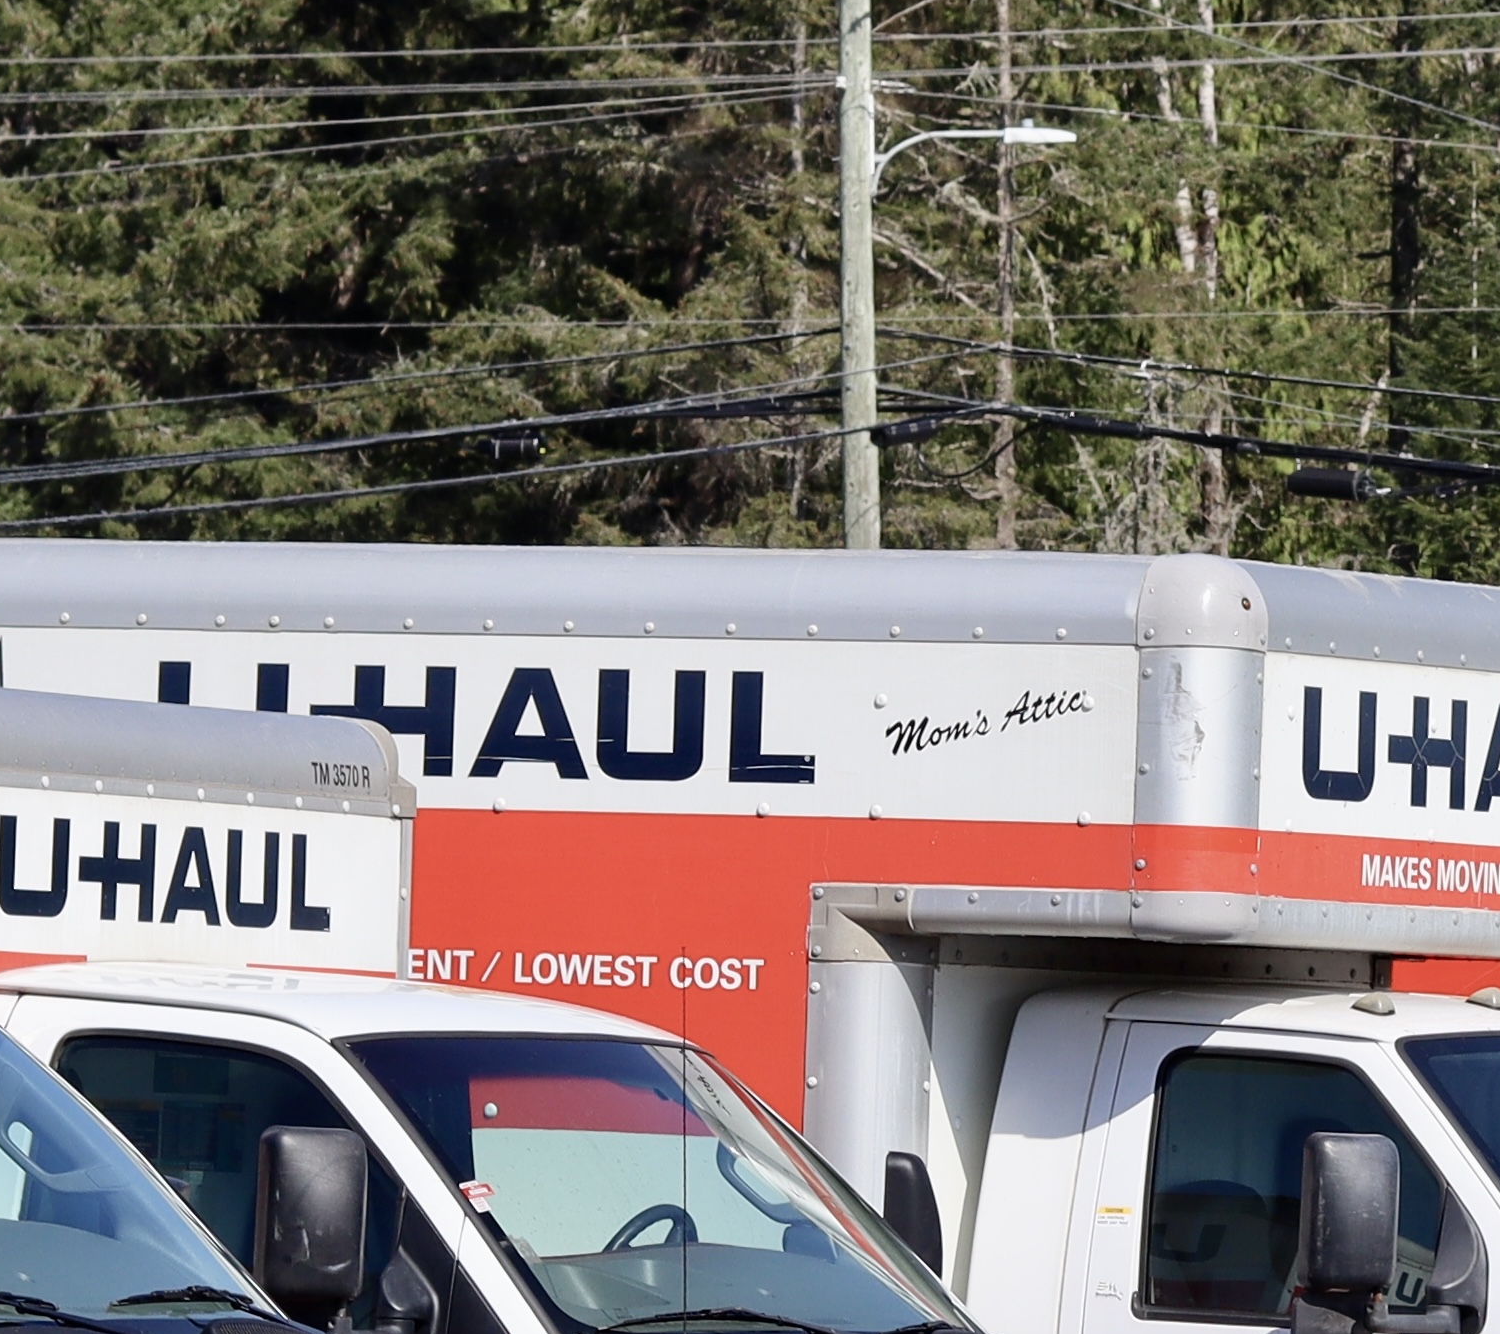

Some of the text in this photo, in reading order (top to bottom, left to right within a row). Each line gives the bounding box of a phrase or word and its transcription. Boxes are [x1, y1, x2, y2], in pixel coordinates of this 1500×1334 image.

[885, 689, 1086, 757] Mom's Attic
[311, 762, 371, 789] TM 3570 R
[1362, 853, 1431, 890] MAKES
[515, 952, 656, 988] LOWEST
[669, 957, 764, 991] COST
